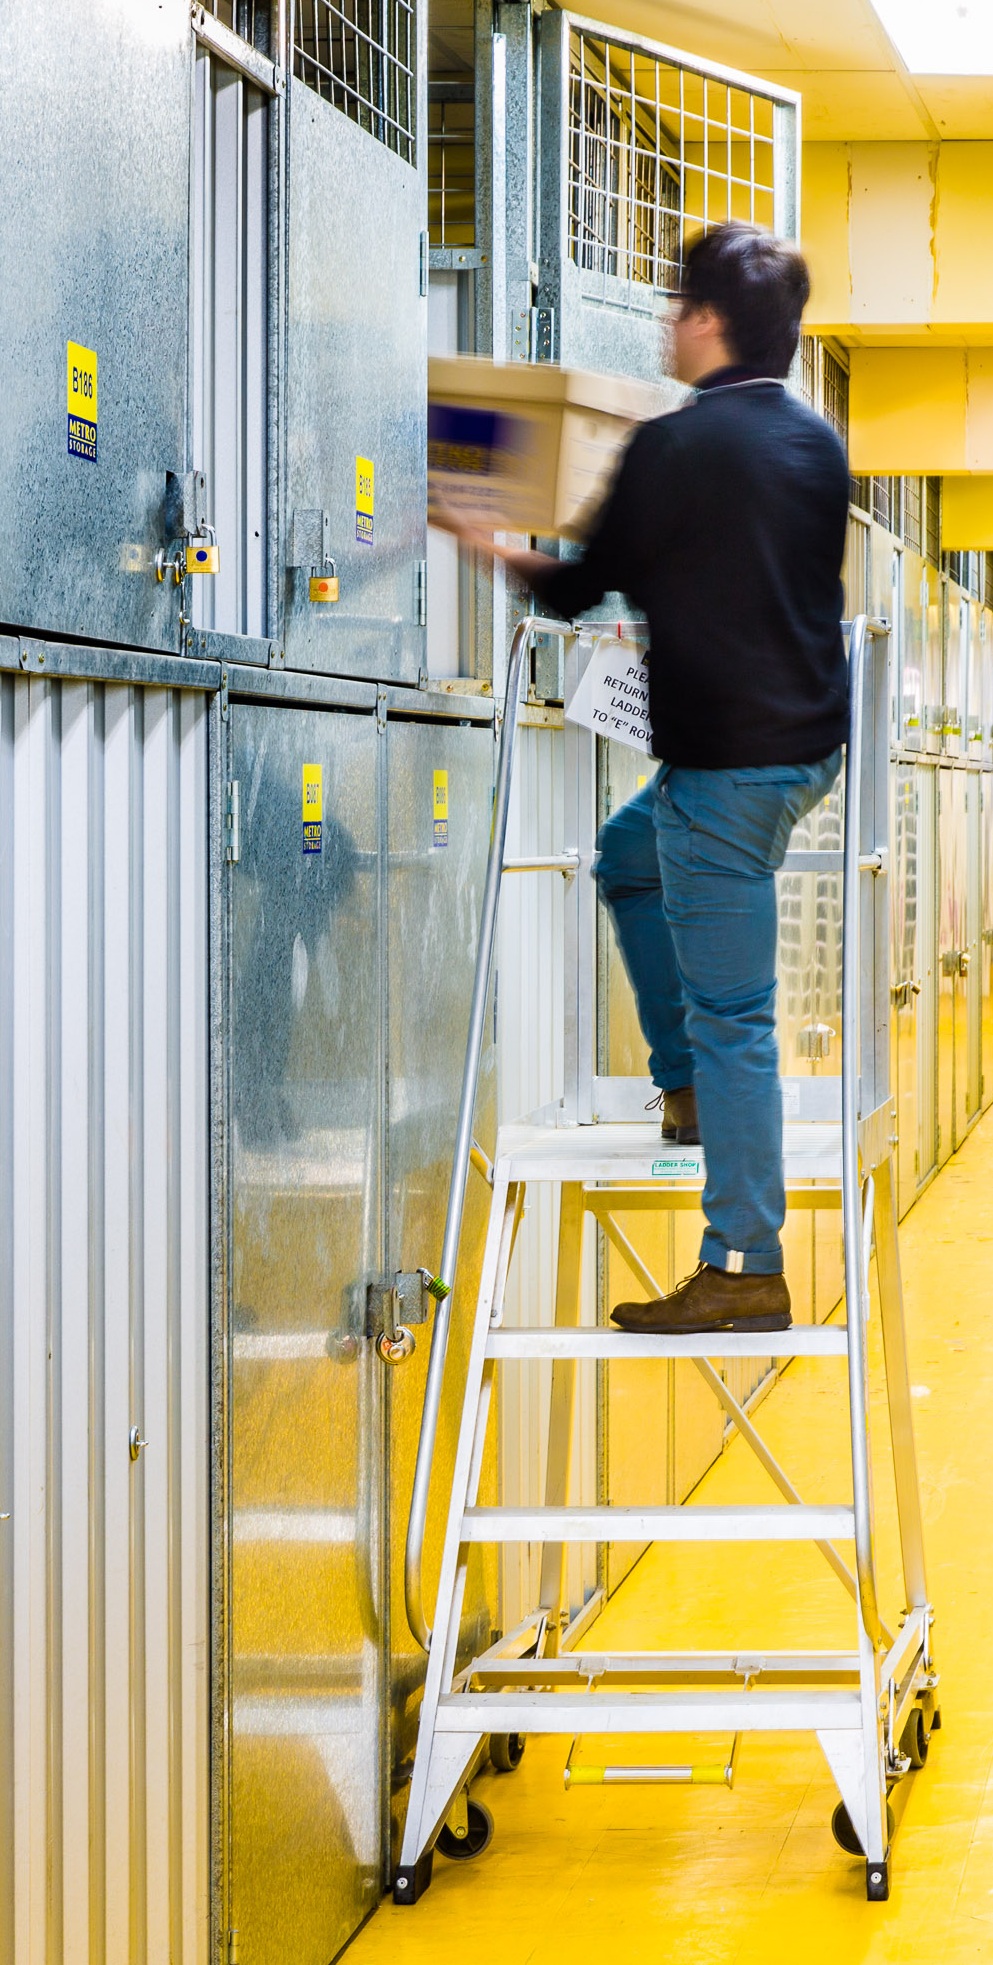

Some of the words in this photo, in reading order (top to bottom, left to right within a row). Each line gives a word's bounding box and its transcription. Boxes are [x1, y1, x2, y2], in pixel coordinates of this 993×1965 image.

[73, 366, 92, 399] B186
[69, 419, 96, 442] METRO
[69, 440, 96, 458] STORAGE
[603, 676, 649, 702] RETURN
[592, 709, 608, 723] TO
[303, 825, 322, 838] METRO
